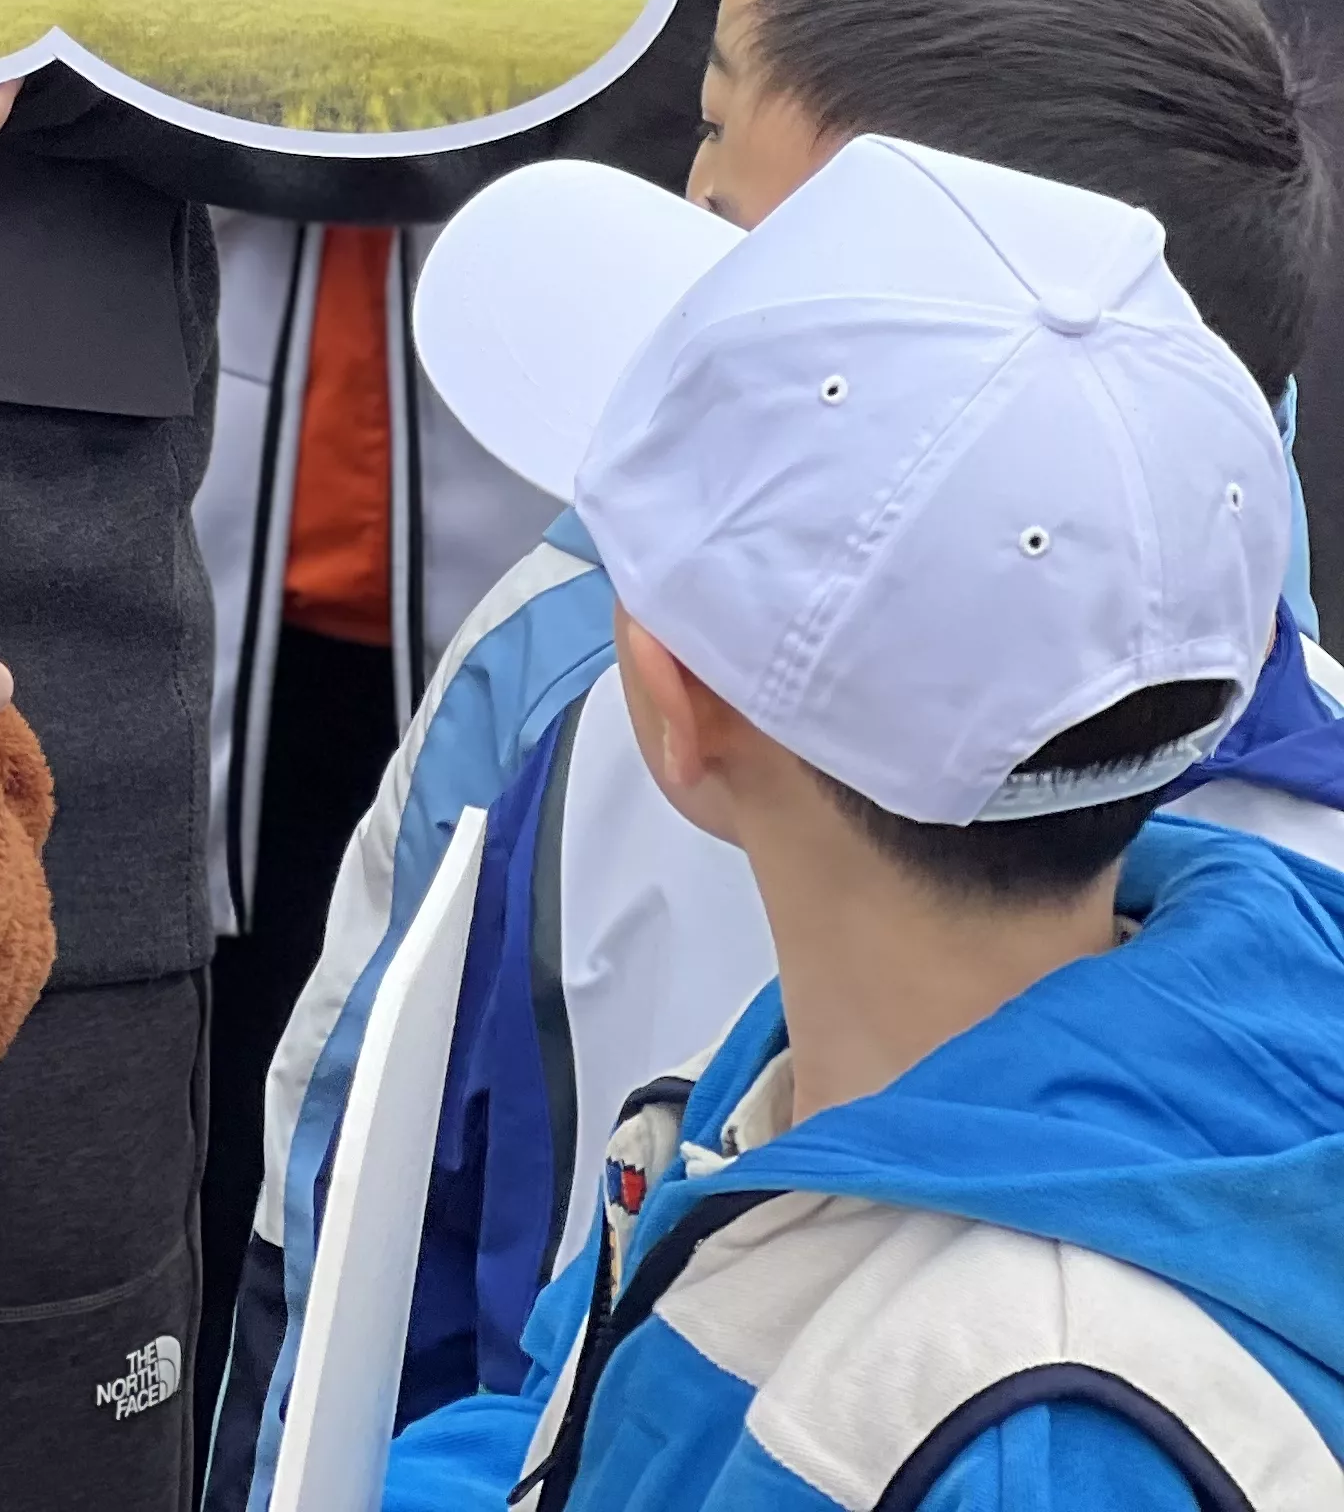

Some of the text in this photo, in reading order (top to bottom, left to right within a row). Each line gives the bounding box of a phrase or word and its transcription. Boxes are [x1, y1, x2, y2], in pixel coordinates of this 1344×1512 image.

[125, 1341, 157, 1374] THE
[96, 1361, 160, 1407] NORTH
[115, 1383, 160, 1421] FACE
